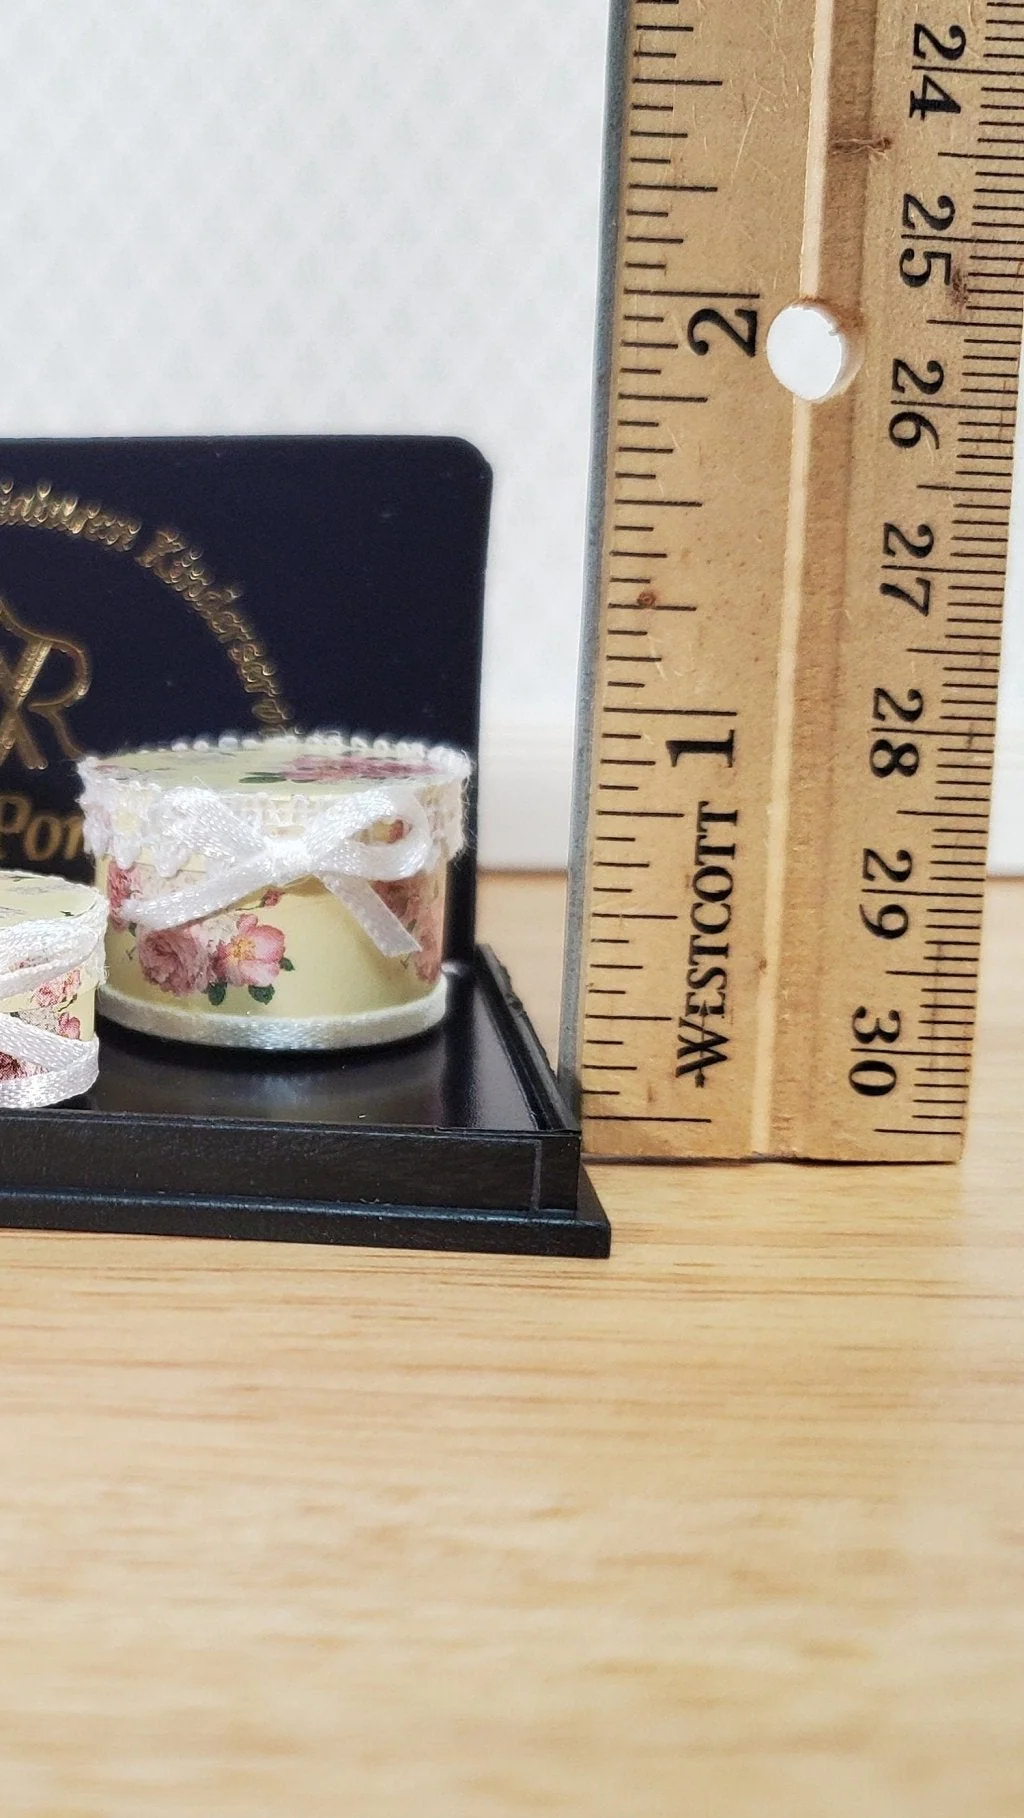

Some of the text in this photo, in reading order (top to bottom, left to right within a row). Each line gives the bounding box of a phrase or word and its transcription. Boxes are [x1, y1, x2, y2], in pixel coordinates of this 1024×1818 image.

[686, 307, 758, 358] 2
[848, 22, 967, 1097] 24 25 26 27 28 29 30
[664, 728, 737, 768] 1
[675, 800, 739, 1086] WESTCOTT
